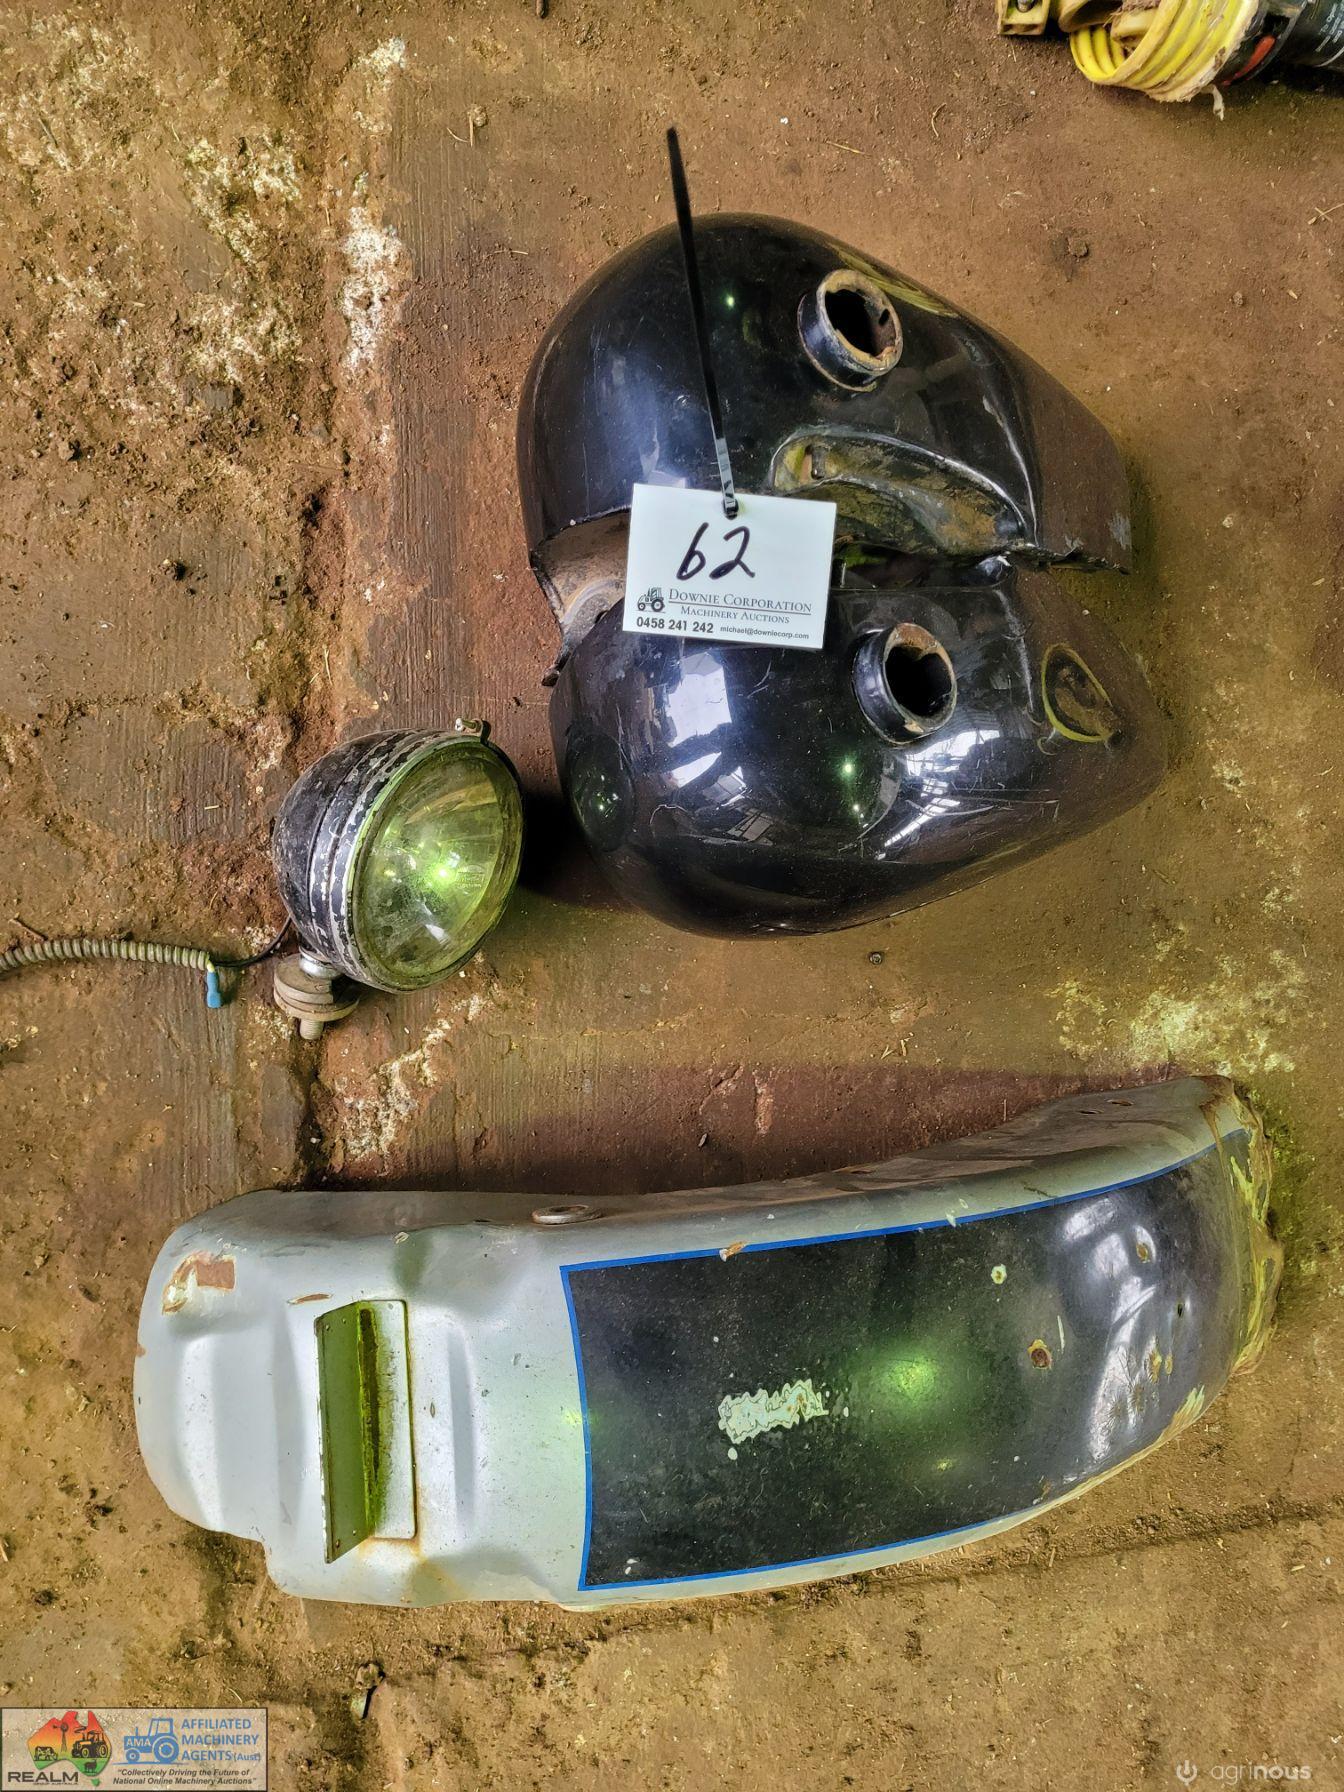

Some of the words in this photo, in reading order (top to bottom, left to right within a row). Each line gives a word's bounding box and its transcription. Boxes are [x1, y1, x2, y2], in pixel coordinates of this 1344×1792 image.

[676, 522, 756, 581] 62
[668, 588, 719, 604] DOWNIE
[723, 593, 812, 612] CORPORATION
[681, 606, 738, 619] MACHINERY
[740, 611, 790, 624] AUCTIONS
[636, 616, 665, 629] 0458
[668, 619, 687, 631] 241
[692, 622, 714, 633] 242
[719, 626, 809, 640] michael@downiecorp.com
